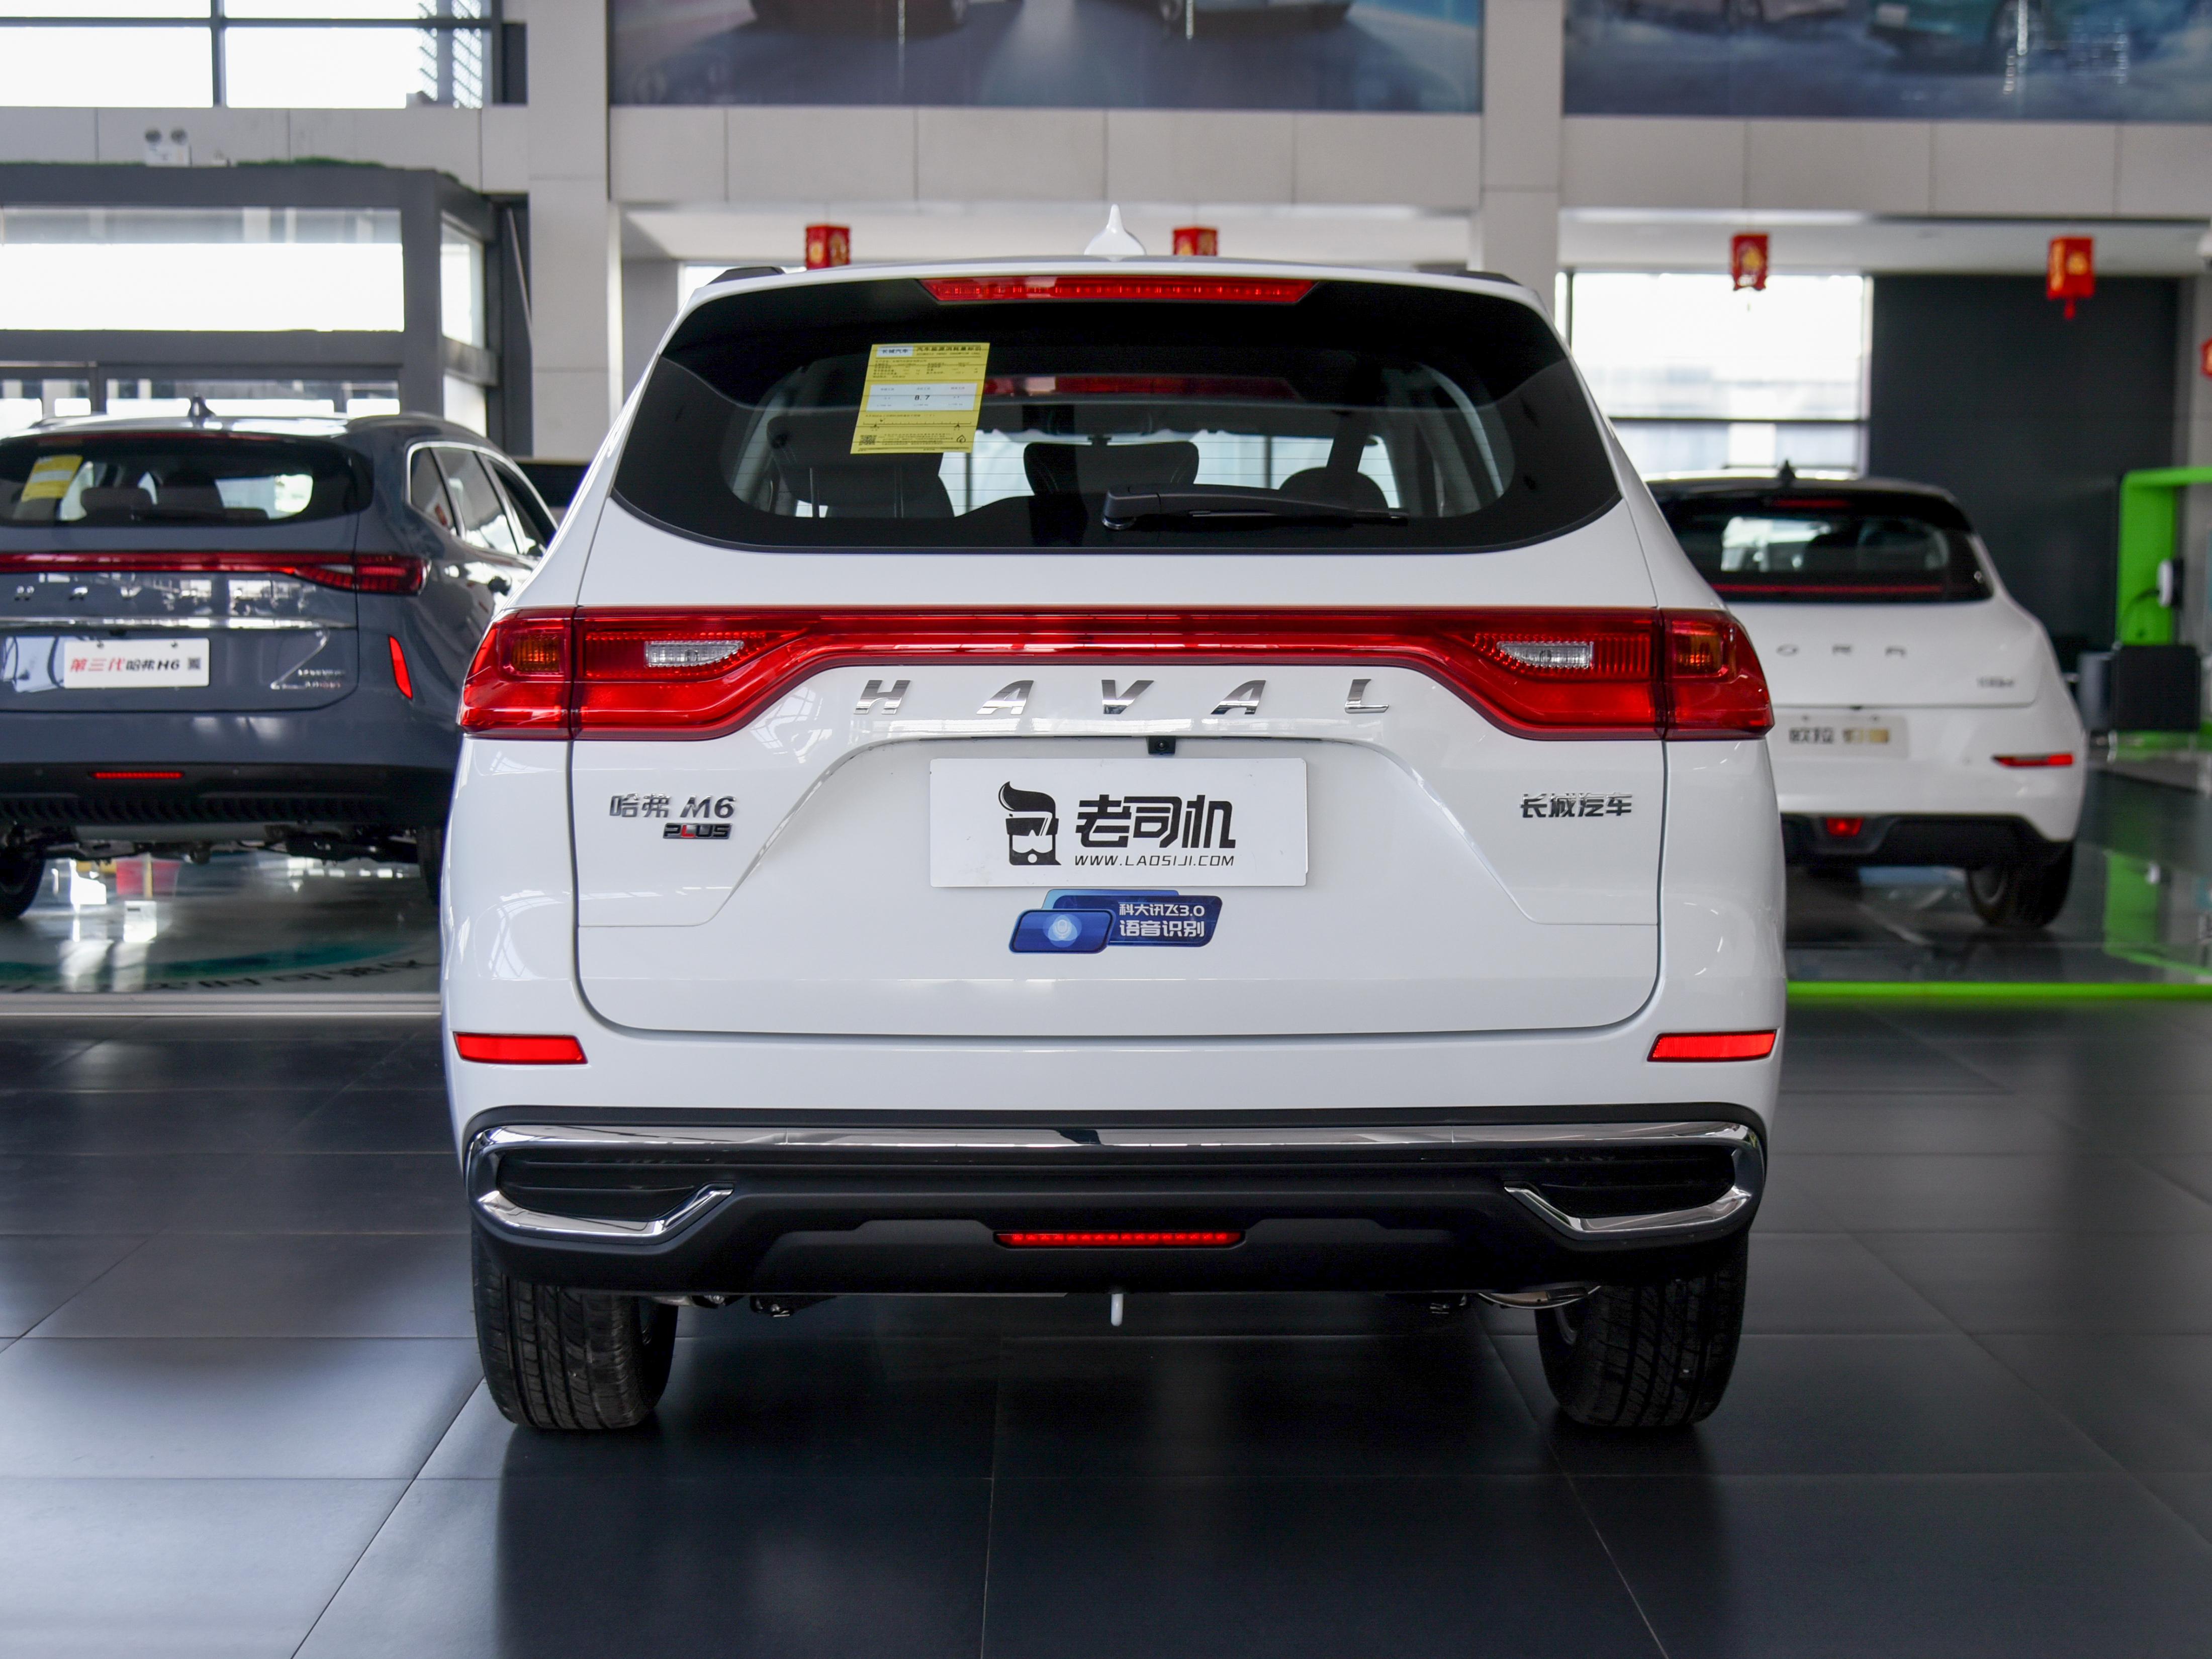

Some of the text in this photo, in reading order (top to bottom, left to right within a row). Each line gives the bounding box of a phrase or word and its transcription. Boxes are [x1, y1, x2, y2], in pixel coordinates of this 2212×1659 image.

[853, 679, 1390, 715] HAVAL
[609, 792, 736, 818] 哈弗 M6
[1520, 792, 1633, 818] 长城汽车
[664, 823, 731, 839] PLUS
[1075, 794, 1236, 849] 老司机
[1074, 855, 1235, 866] WWW.LAOSIJI.COM
[1119, 903, 1205, 917] 科大讯飞3.0
[1120, 920, 1205, 937] 语音识别
